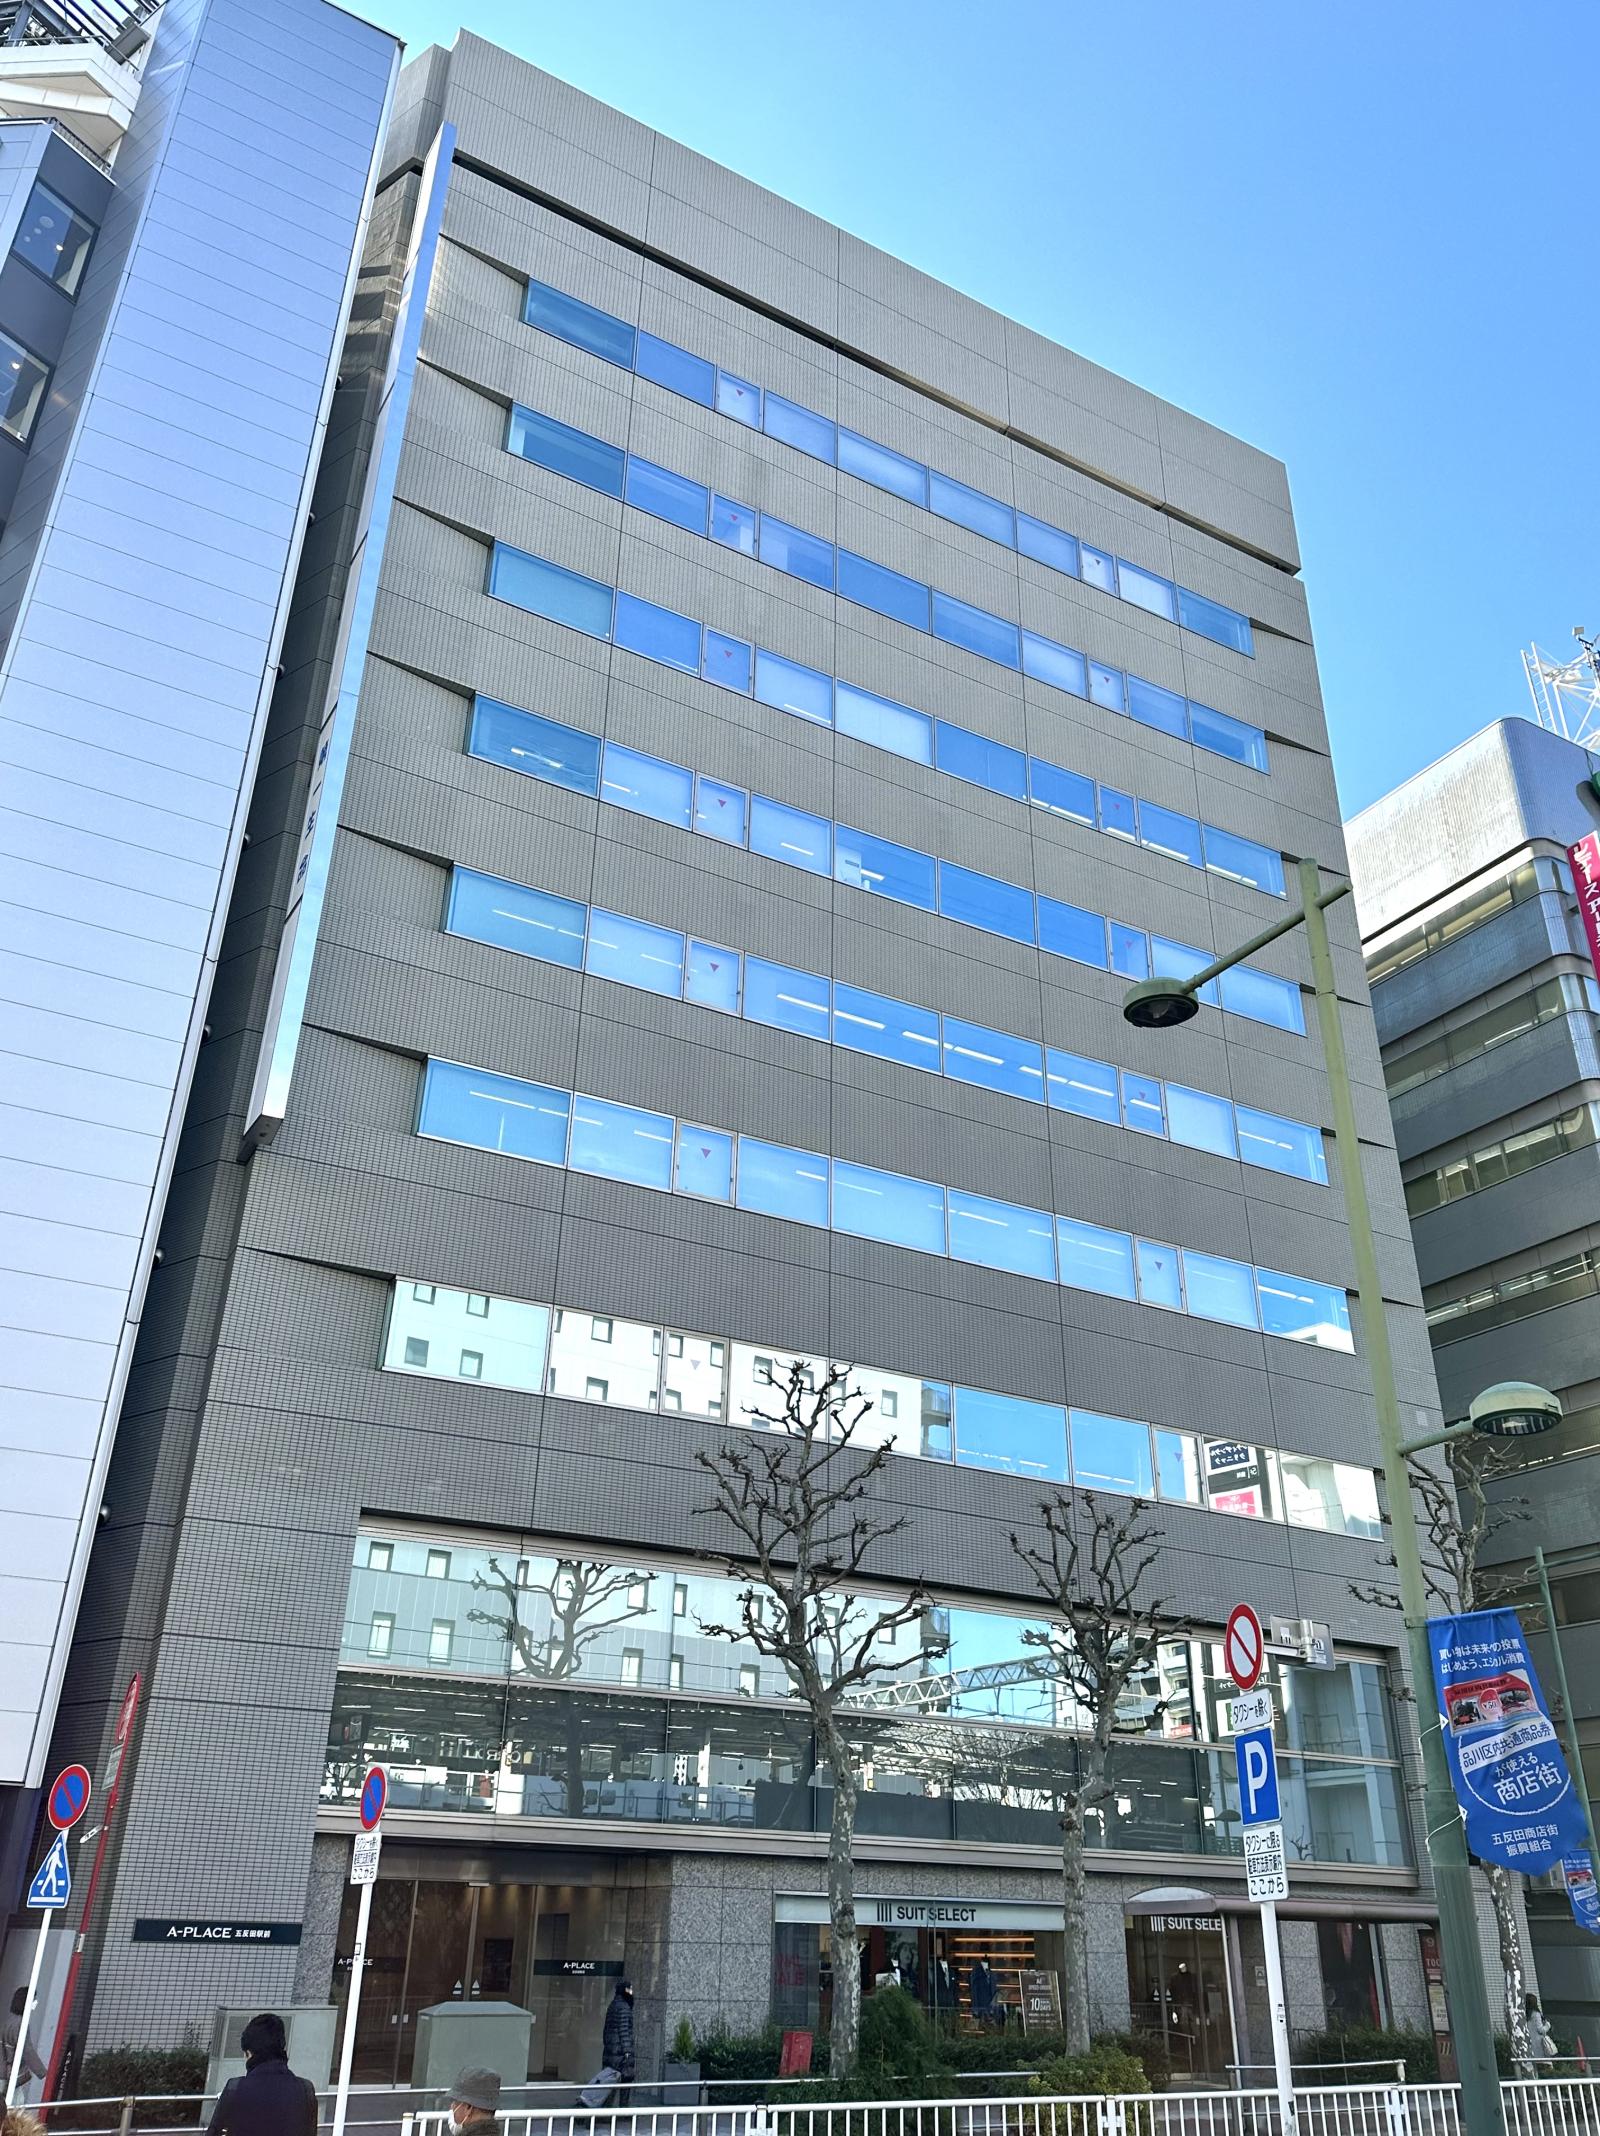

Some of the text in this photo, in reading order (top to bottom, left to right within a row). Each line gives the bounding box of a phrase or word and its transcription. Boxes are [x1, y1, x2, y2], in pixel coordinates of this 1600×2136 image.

[1233, 1698, 1268, 1724] タクシーを除く
[1462, 1722, 1552, 1768] 品川区内共通商品券
[1495, 1751, 1538, 1778] が使える
[1244, 1740, 1268, 1815] P
[1493, 1762, 1562, 1805] 商店街
[1246, 1831, 1281, 1853] タクシーに限る
[1492, 1824, 1559, 1846] 五反田商店街
[1506, 1839, 1552, 1857] 振興組合
[1250, 1877, 1285, 1896] ここから
[896, 1906, 976, 1922] SUIT SELECT
[1167, 1917, 1222, 1931] SUIT SELE
[166, 1926, 232, 1939] A-PLACE
[337, 1958, 374, 1966] A-PCE
[563, 1961, 596, 1970] A-PLACE
